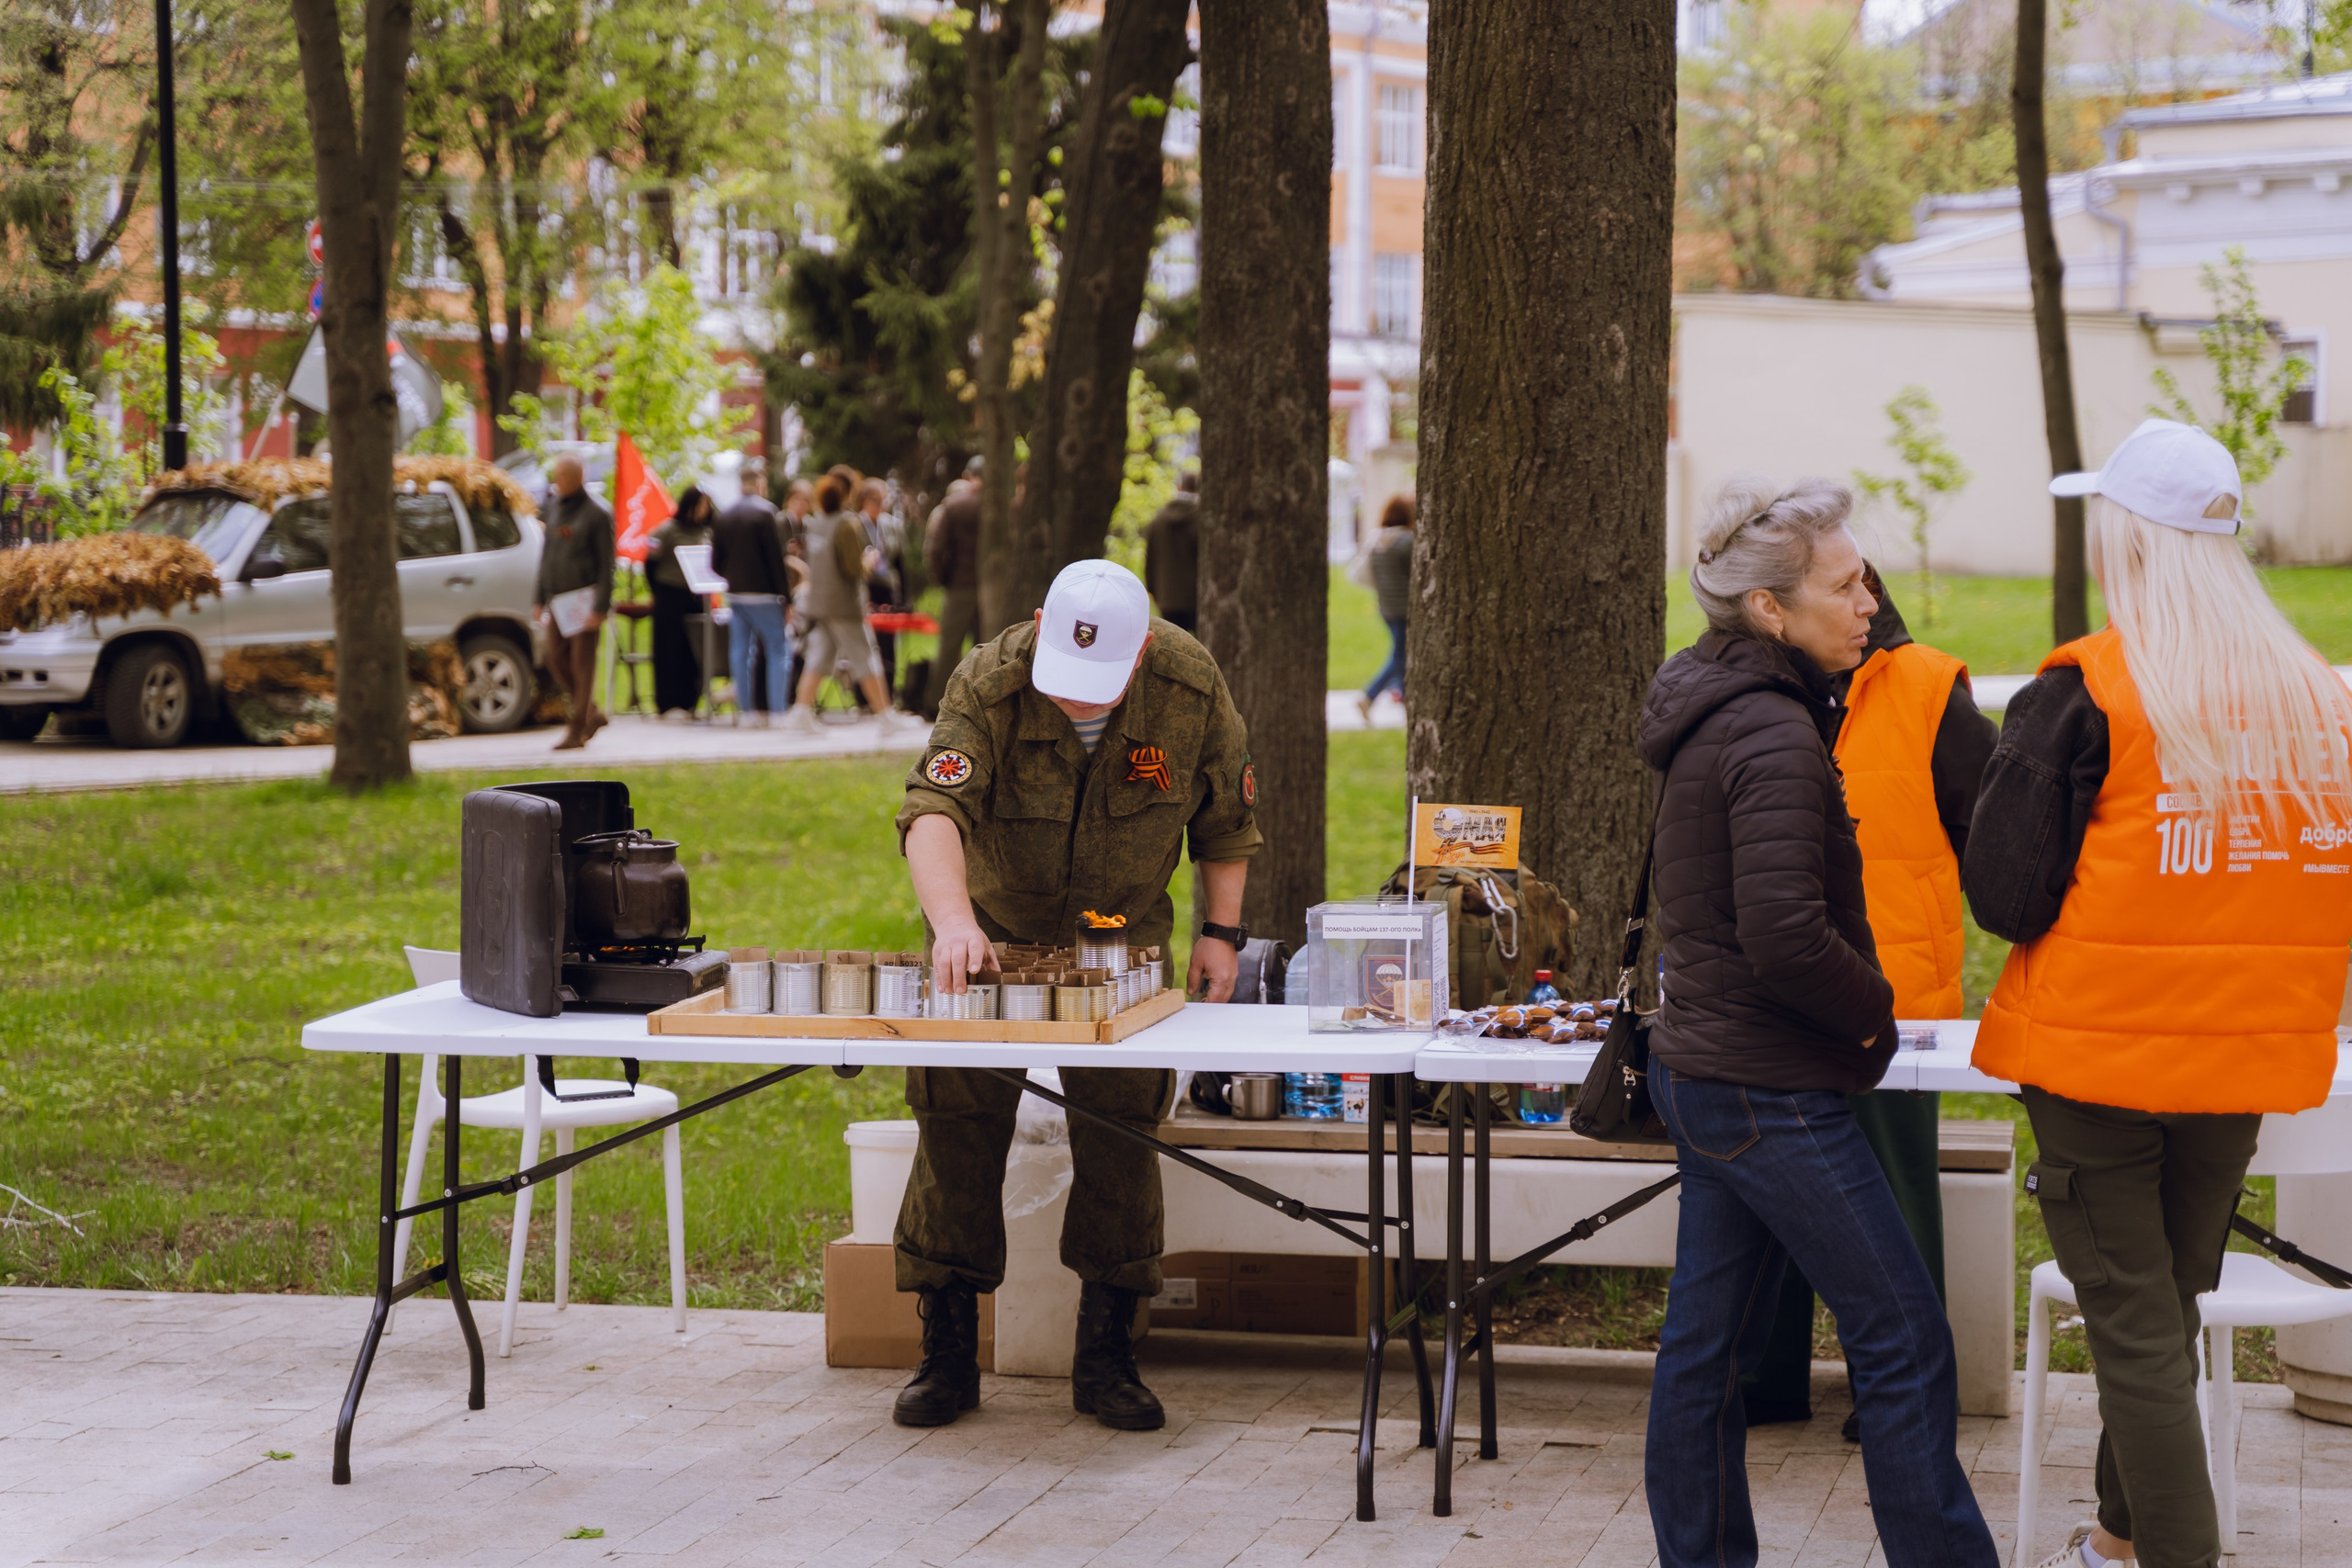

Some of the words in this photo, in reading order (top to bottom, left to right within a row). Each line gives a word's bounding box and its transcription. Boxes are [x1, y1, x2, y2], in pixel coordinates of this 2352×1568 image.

[2166, 795, 2202, 808] СОСАВ
[1463, 817, 1507, 841] МАЯ
[2229, 839, 2262, 849] ТЕРПЕНИЯ
[2228, 851, 2261, 861] ЖЕЛАНИЯ
[2262, 851, 2290, 861] ПОМОЧЬ
[2227, 863, 2252, 873] ЛЮБВИ
[2303, 863, 2350, 874] #МЫВМЕСТЕ
[1353, 925, 1378, 933] БОЙЦАМ
